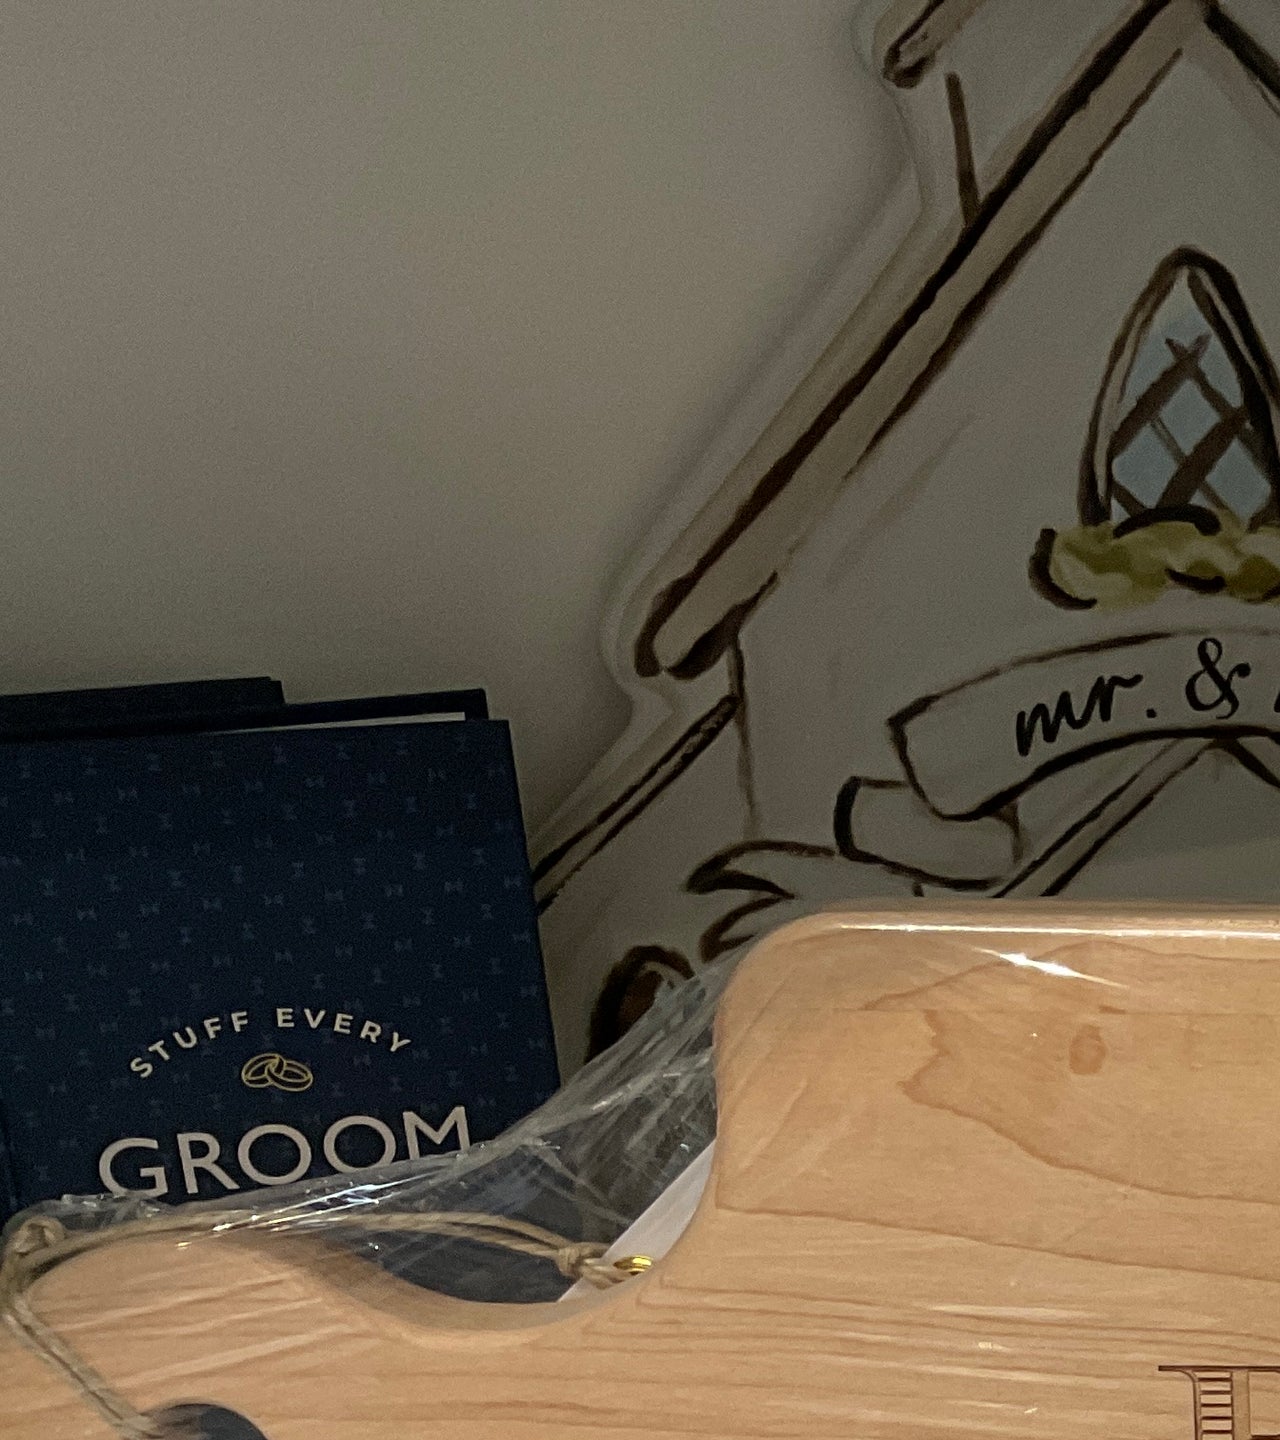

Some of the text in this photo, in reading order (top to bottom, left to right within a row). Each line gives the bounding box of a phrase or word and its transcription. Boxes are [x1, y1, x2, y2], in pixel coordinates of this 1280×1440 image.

[1013, 672, 1158, 757] mr.
[1184, 637, 1251, 719] &
[130, 1007, 412, 1080] STUFF EVERY
[98, 1105, 472, 1199] GROOM
